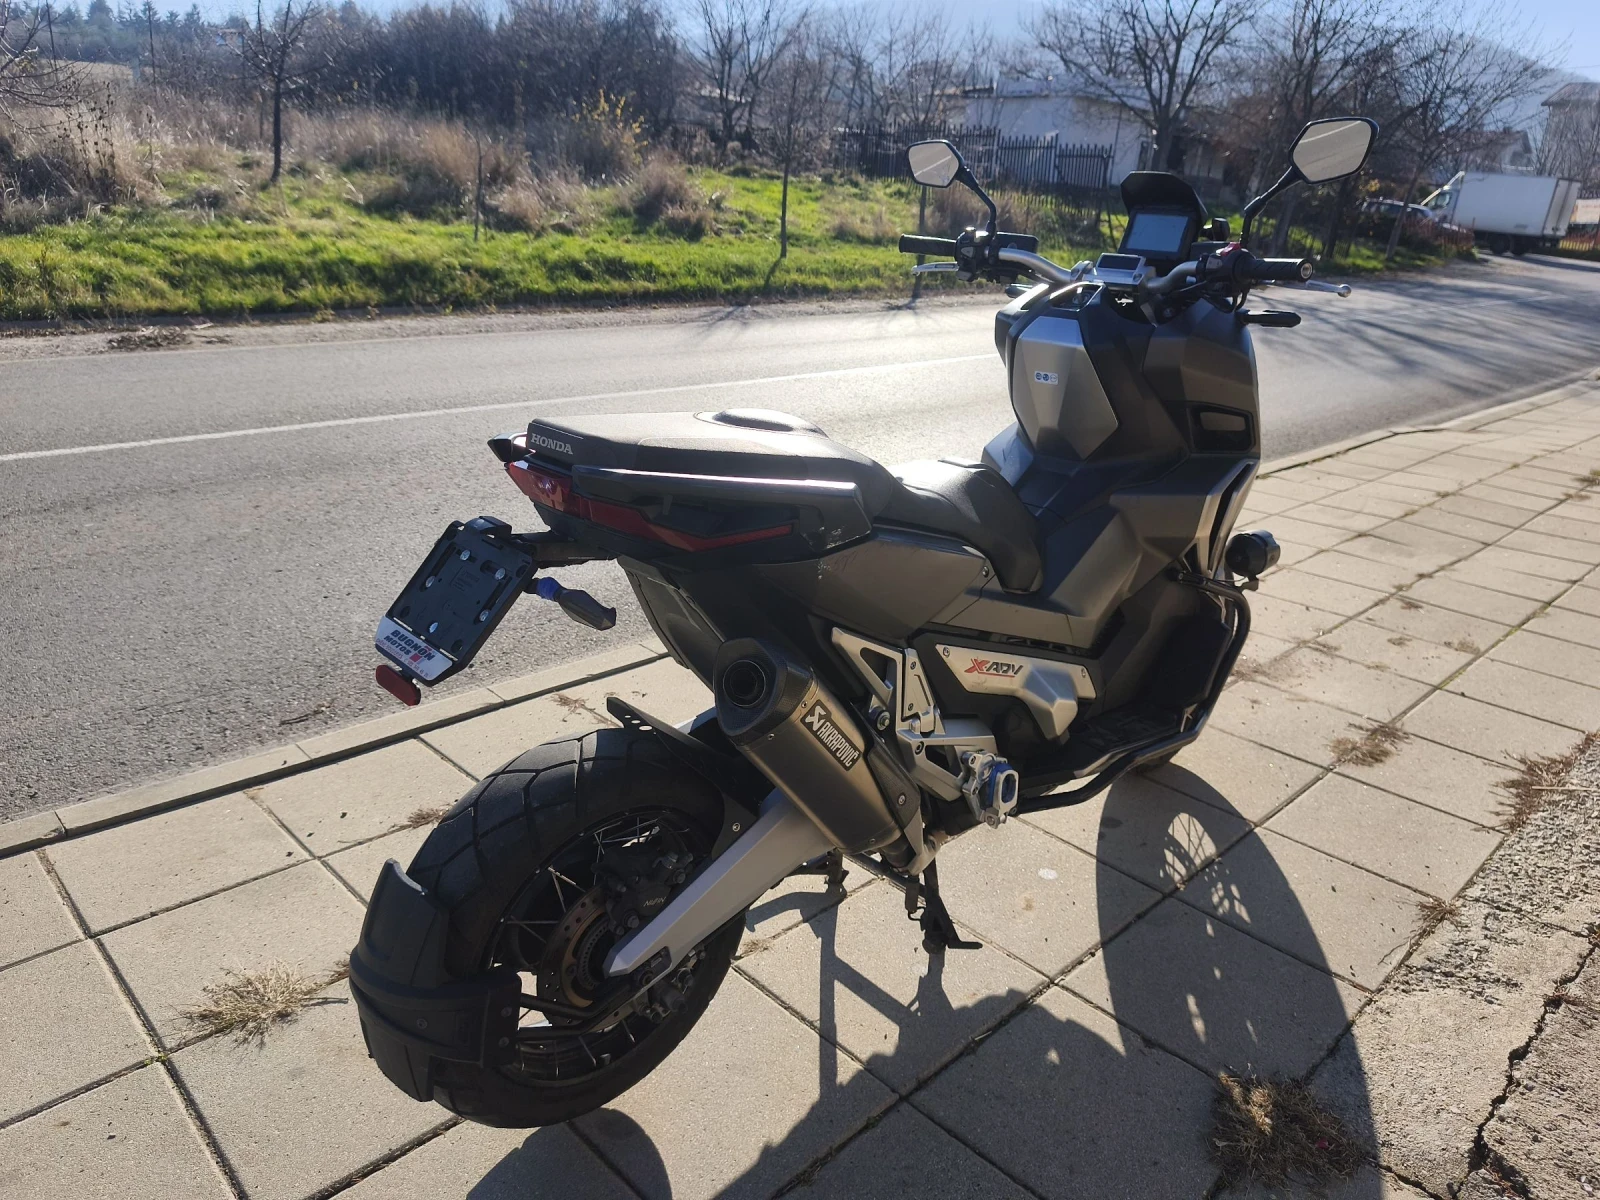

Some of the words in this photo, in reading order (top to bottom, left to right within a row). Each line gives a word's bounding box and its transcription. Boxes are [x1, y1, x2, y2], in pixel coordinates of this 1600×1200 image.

[530, 433, 574, 455] HONDA
[383, 635, 412, 656] MOTOS
[390, 629, 436, 661] BUGNON
